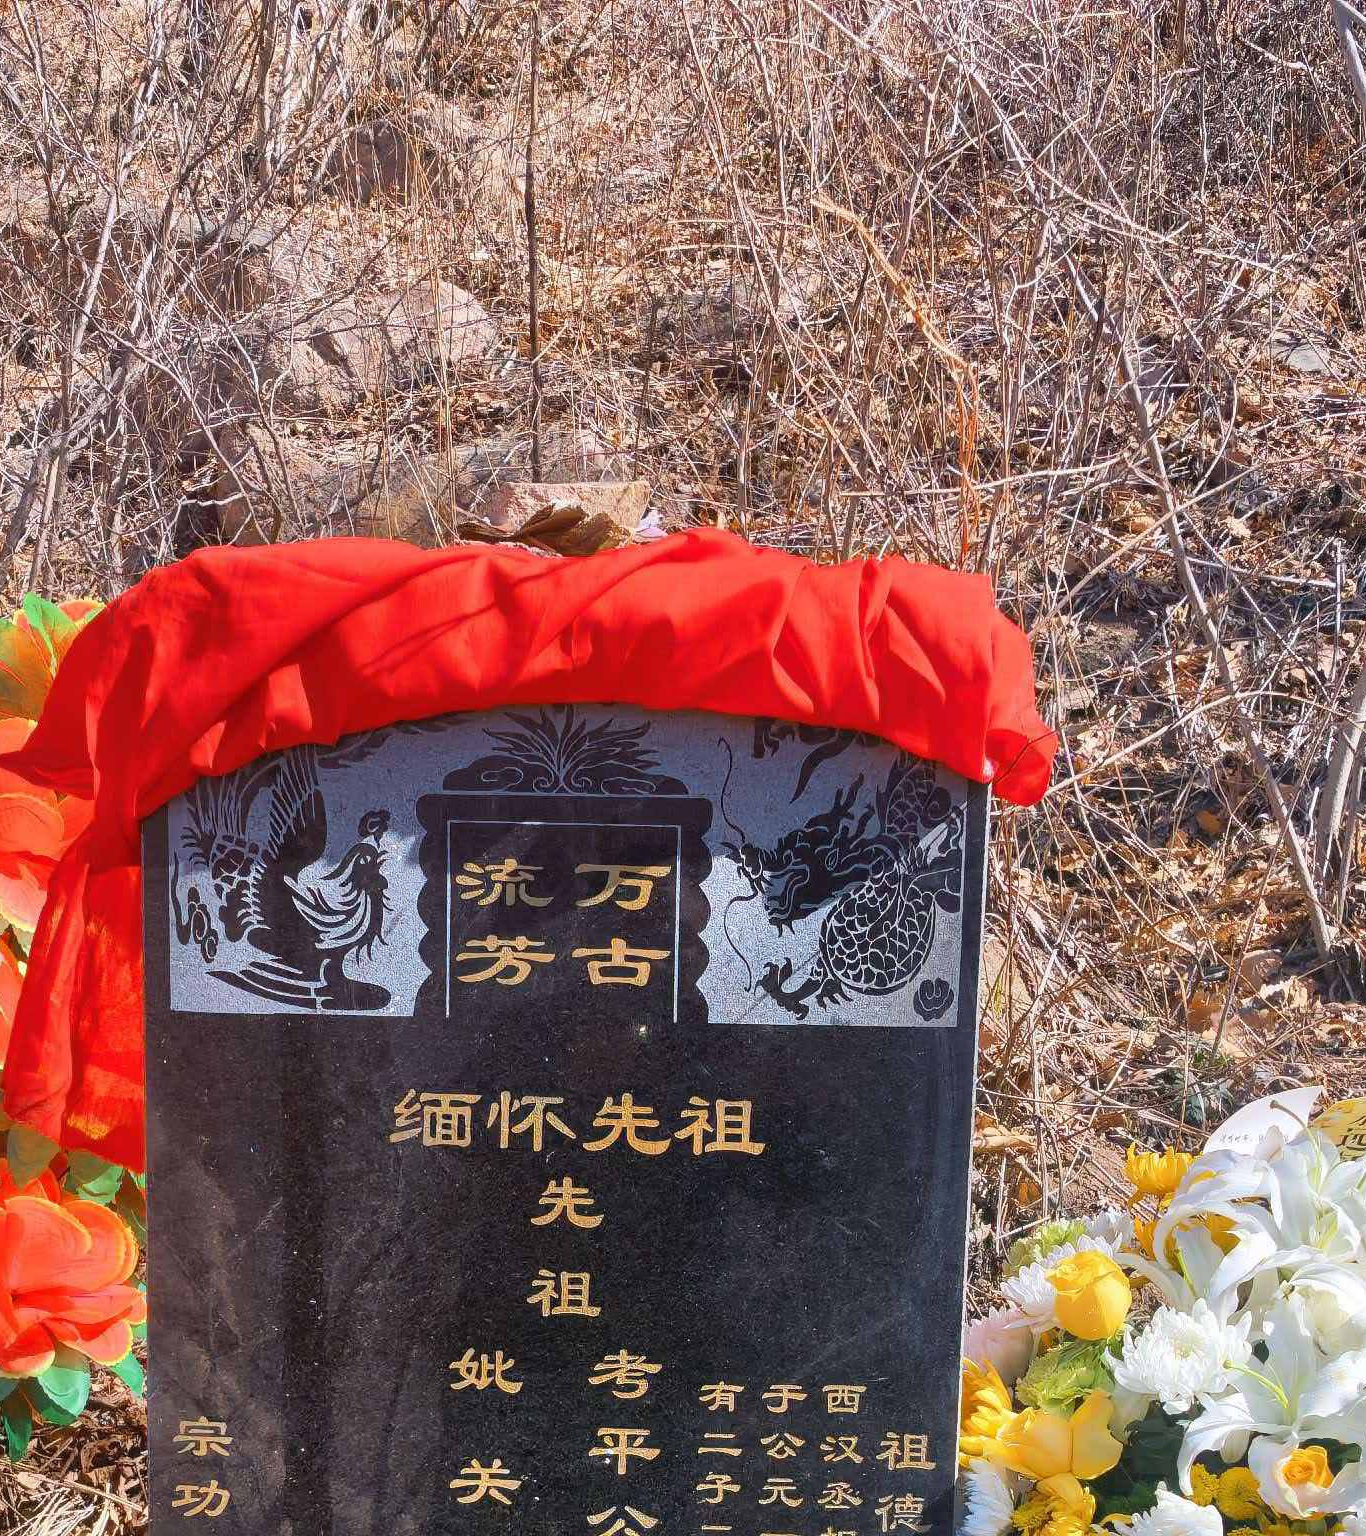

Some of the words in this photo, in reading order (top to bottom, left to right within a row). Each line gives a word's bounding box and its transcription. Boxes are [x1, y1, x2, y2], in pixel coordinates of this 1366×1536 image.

[456, 859, 555, 986] 流芳
[571, 862, 672, 987] 万古
[390, 1088, 766, 1157] 缅怀先祖
[526, 1176, 604, 1318] 先祖
